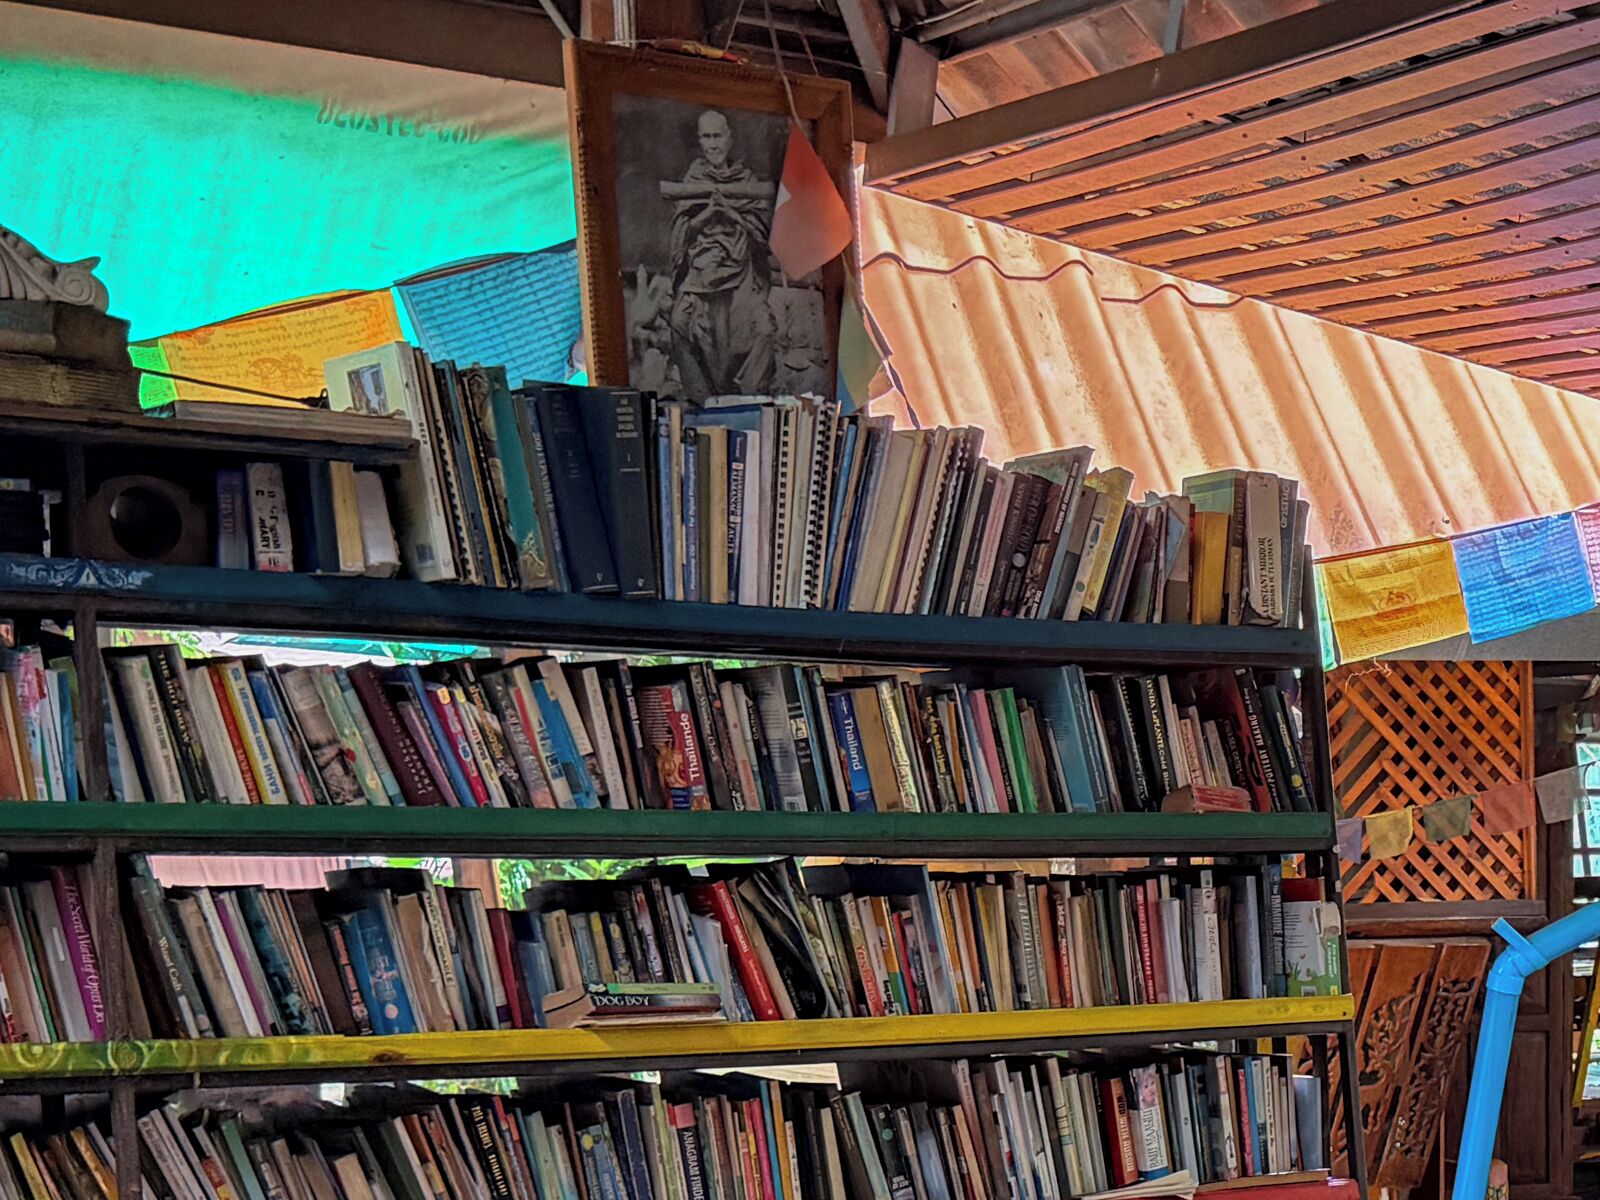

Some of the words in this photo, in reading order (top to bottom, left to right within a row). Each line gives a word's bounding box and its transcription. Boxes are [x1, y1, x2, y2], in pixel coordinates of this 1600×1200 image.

[419, 422, 429, 446] BEER
[1258, 537, 1267, 571] MIRROR
[1266, 537, 1274, 574] TUCHMAN
[1259, 572, 1269, 607] DISTANT
[1145, 678, 1156, 708] LYNDA
[843, 715, 863, 771] Thailand
[1270, 894, 1282, 935] IMMUNE
[76, 932, 94, 963] World
[594, 996, 625, 1006] DOG
[625, 996, 648, 1006] BOY
[683, 1130, 699, 1176] ANAGRAM
